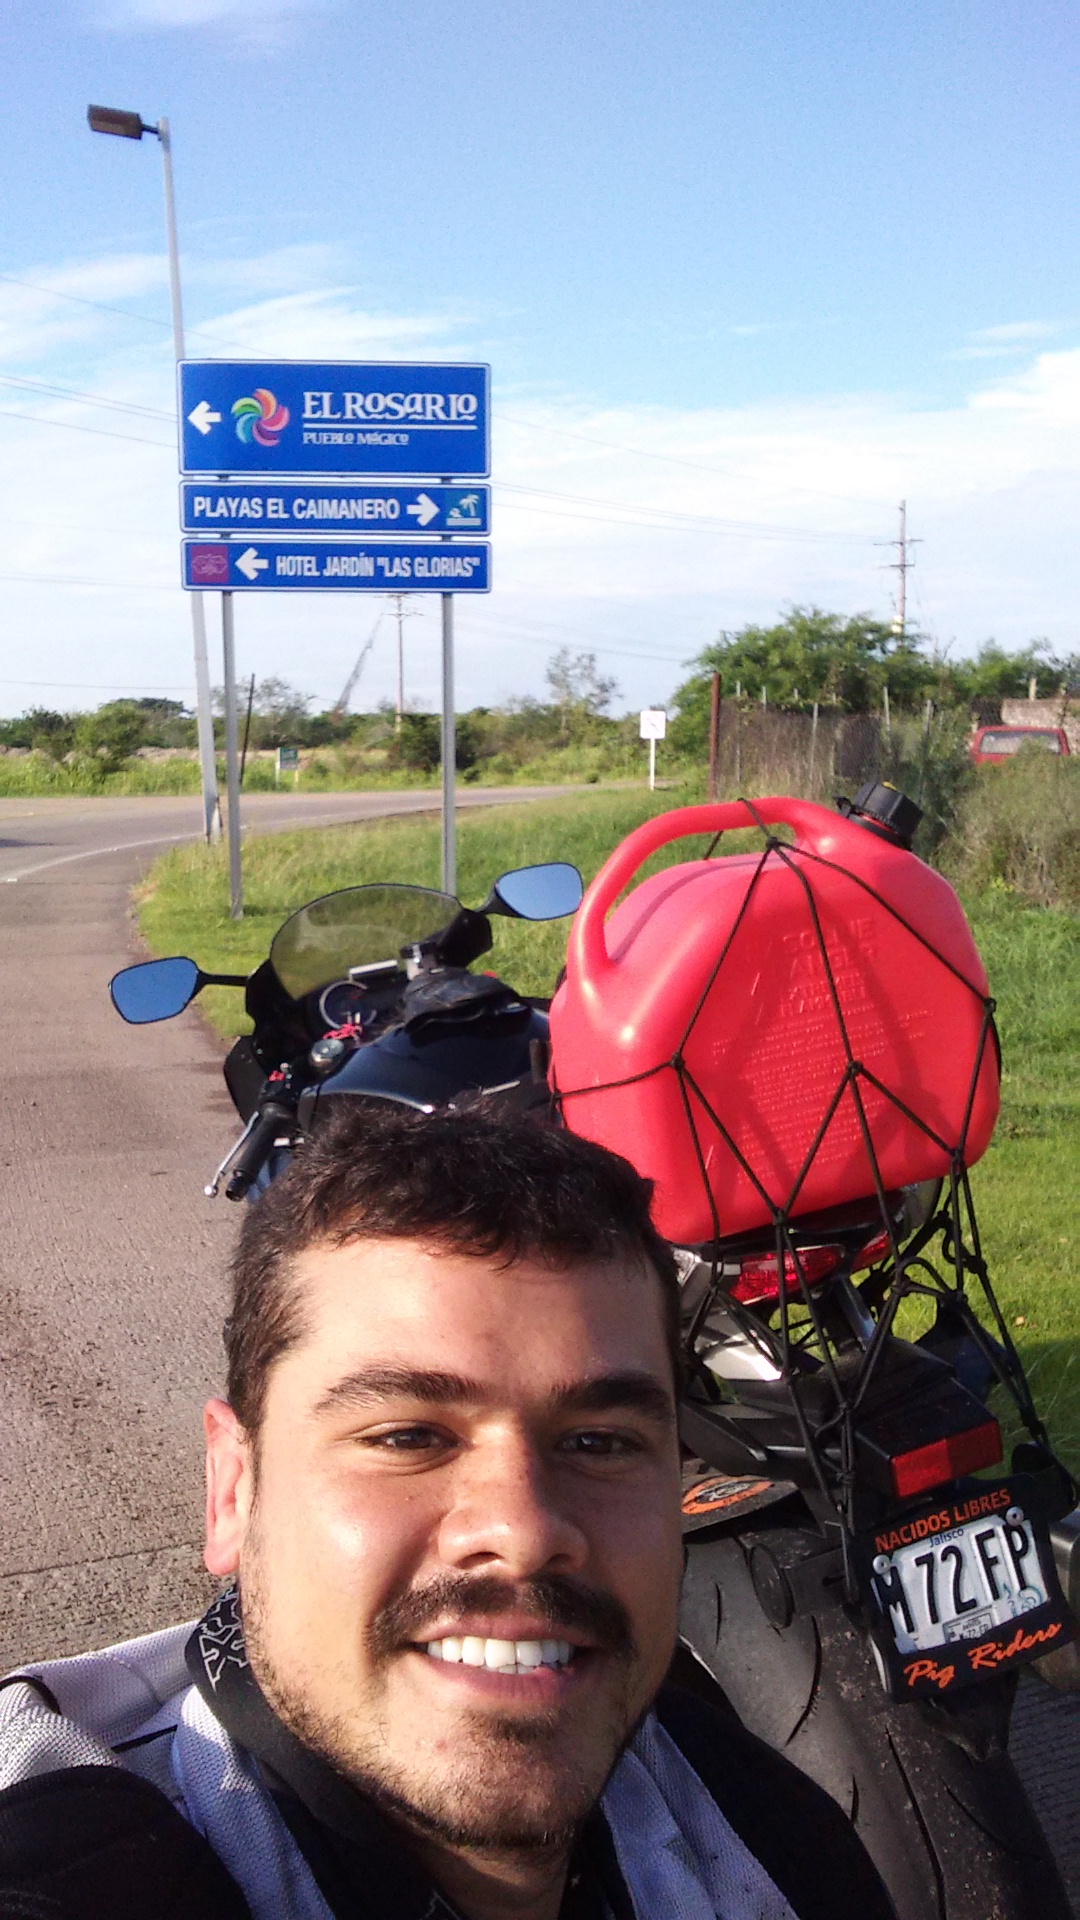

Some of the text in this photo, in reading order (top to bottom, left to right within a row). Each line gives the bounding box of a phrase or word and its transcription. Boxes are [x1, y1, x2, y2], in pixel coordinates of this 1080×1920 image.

[302, 391, 341, 419] EL
[302, 431, 354, 445] PUEBLO
[193, 496, 401, 520] PLAYAS EL CAIMANERO
[276, 551, 481, 578] HOTEL JARDÍN "LAS GLORIAS"
[875, 1488, 1012, 1553] NACIDOS LIBRES
[929, 1527, 965, 1549] Jalisco
[903, 1659, 956, 1689] Pig
[967, 1622, 1063, 1671] Riders
